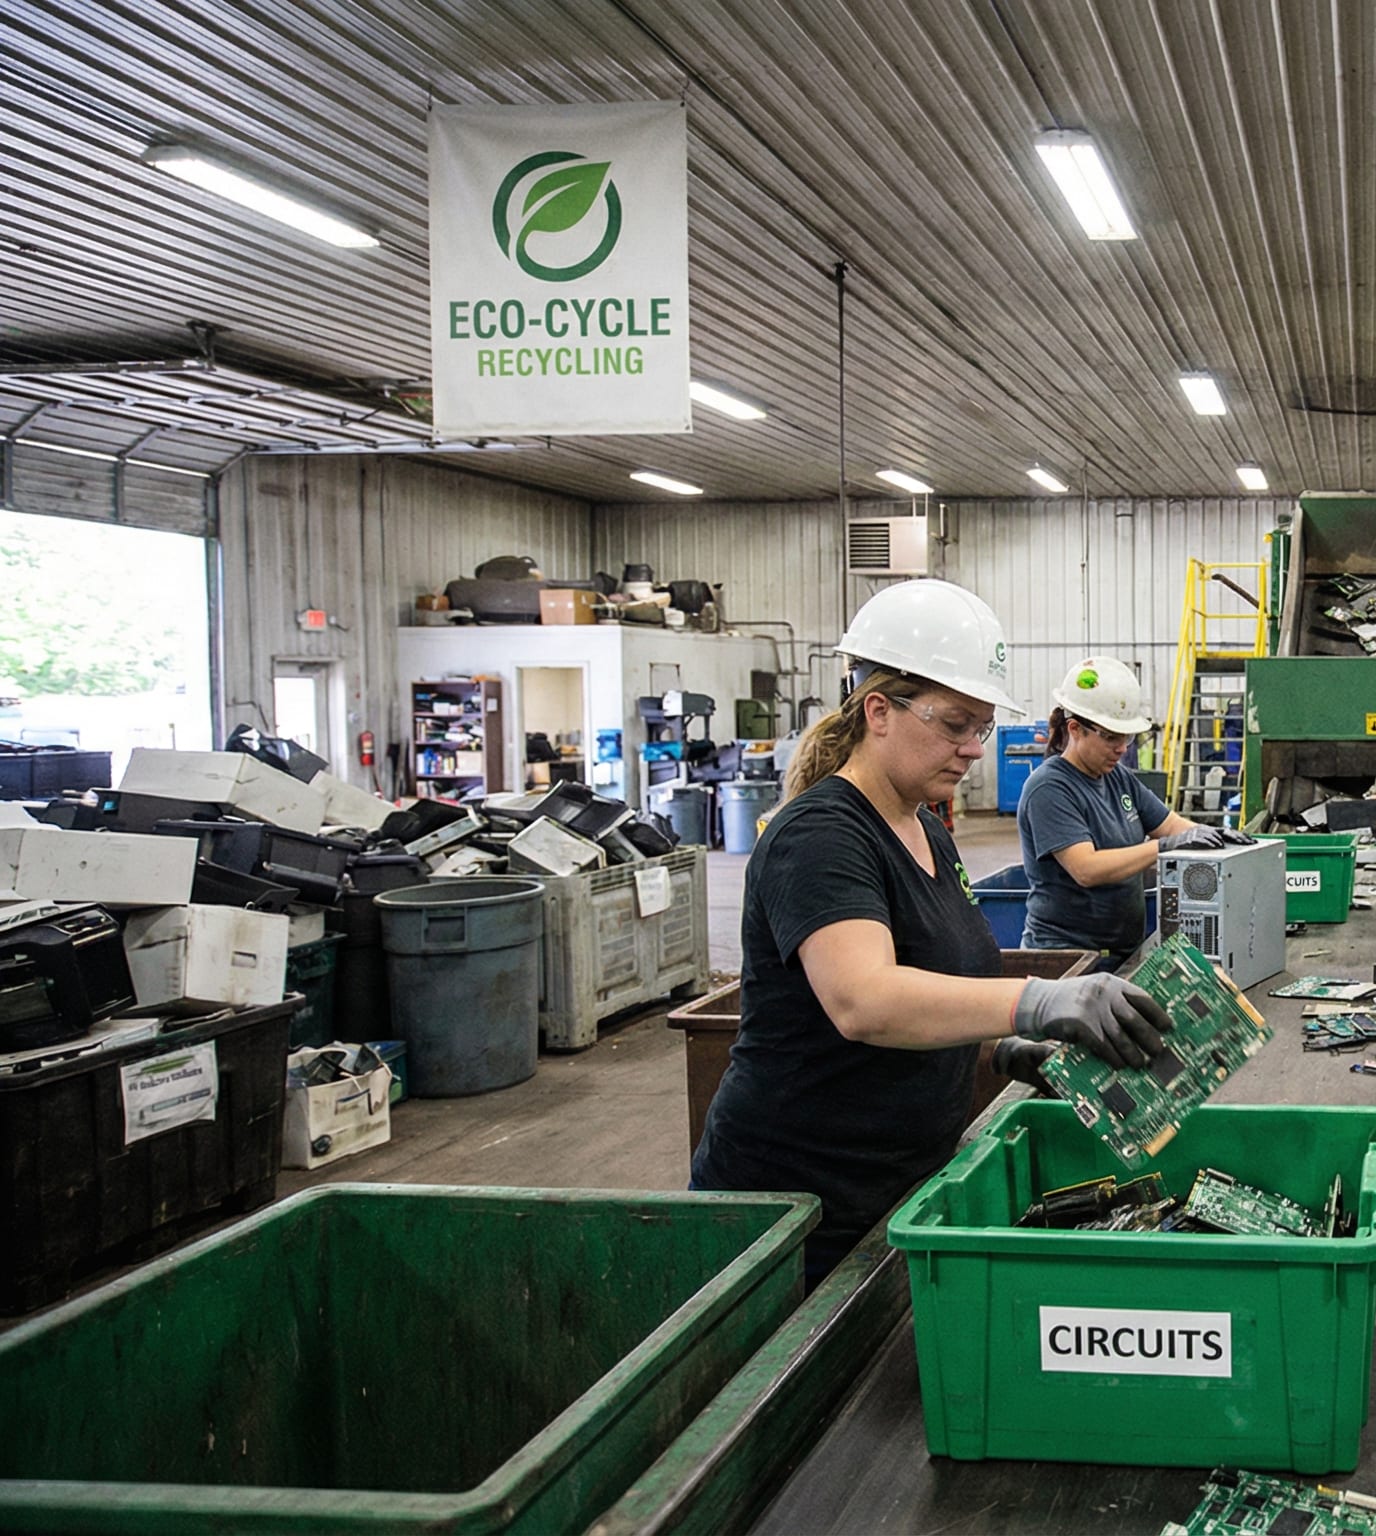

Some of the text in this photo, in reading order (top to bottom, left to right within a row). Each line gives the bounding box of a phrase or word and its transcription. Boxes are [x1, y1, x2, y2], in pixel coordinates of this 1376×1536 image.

[450, 298, 670, 339] ECO-CYCLE
[477, 346, 643, 377] RECYCLING
[1286, 876, 1318, 887] CUITS
[1048, 1325, 1223, 1361] CIRCUITS
